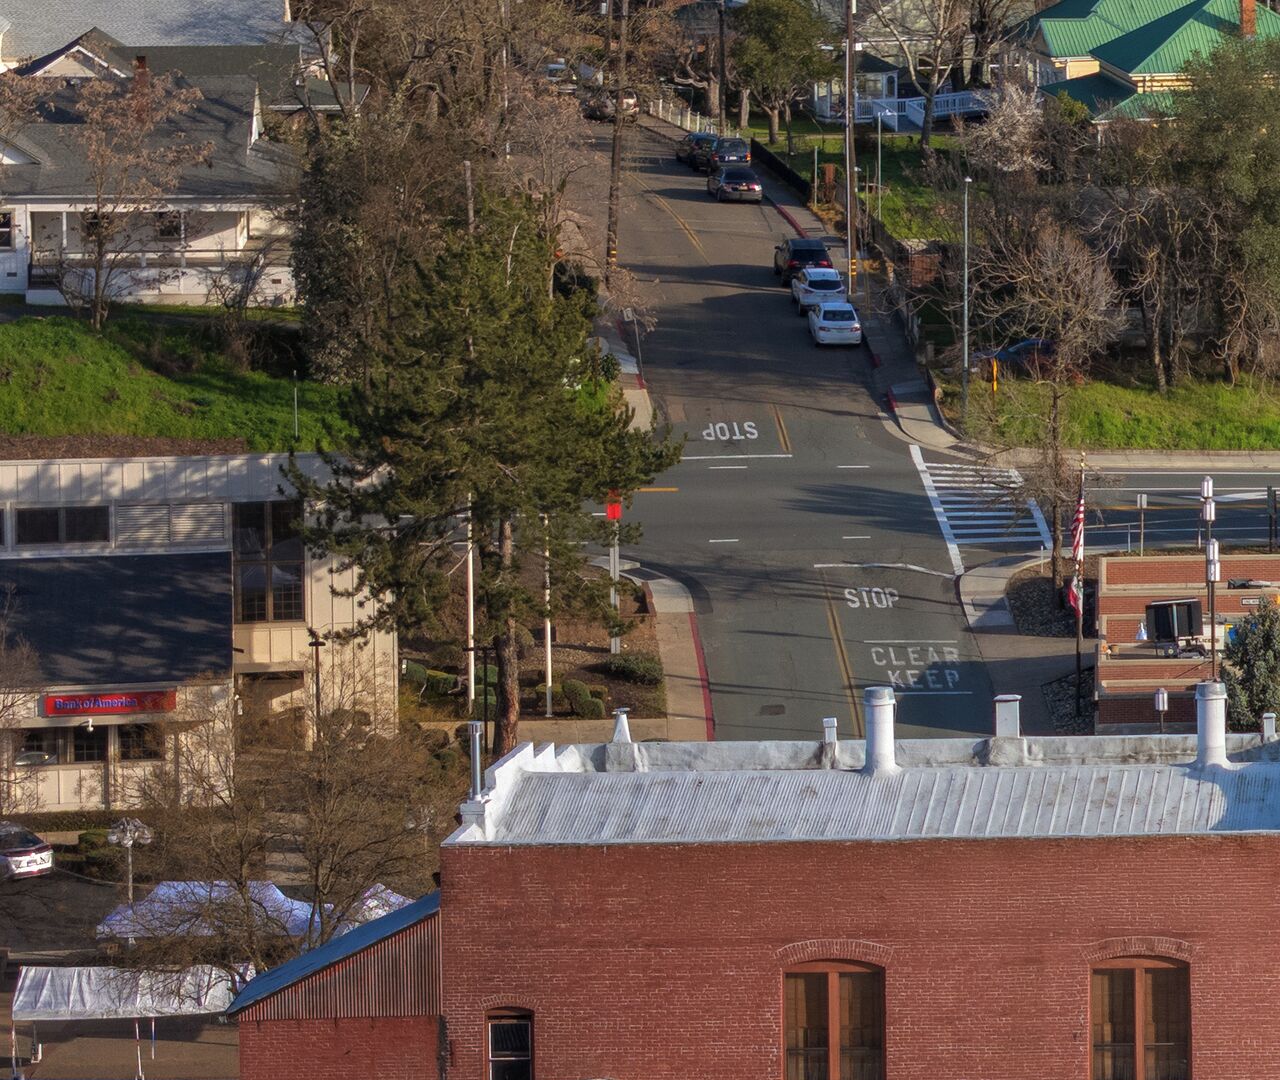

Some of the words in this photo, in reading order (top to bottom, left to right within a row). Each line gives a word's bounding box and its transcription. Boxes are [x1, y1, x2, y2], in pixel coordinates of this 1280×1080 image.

[702, 421, 758, 440] STOP
[844, 587, 899, 608] STOP
[871, 646, 959, 666] CLEAR
[887, 669, 960, 689] KEEP
[55, 698, 81, 710] Bank
[83, 699, 93, 708] of
[95, 697, 138, 708] America
